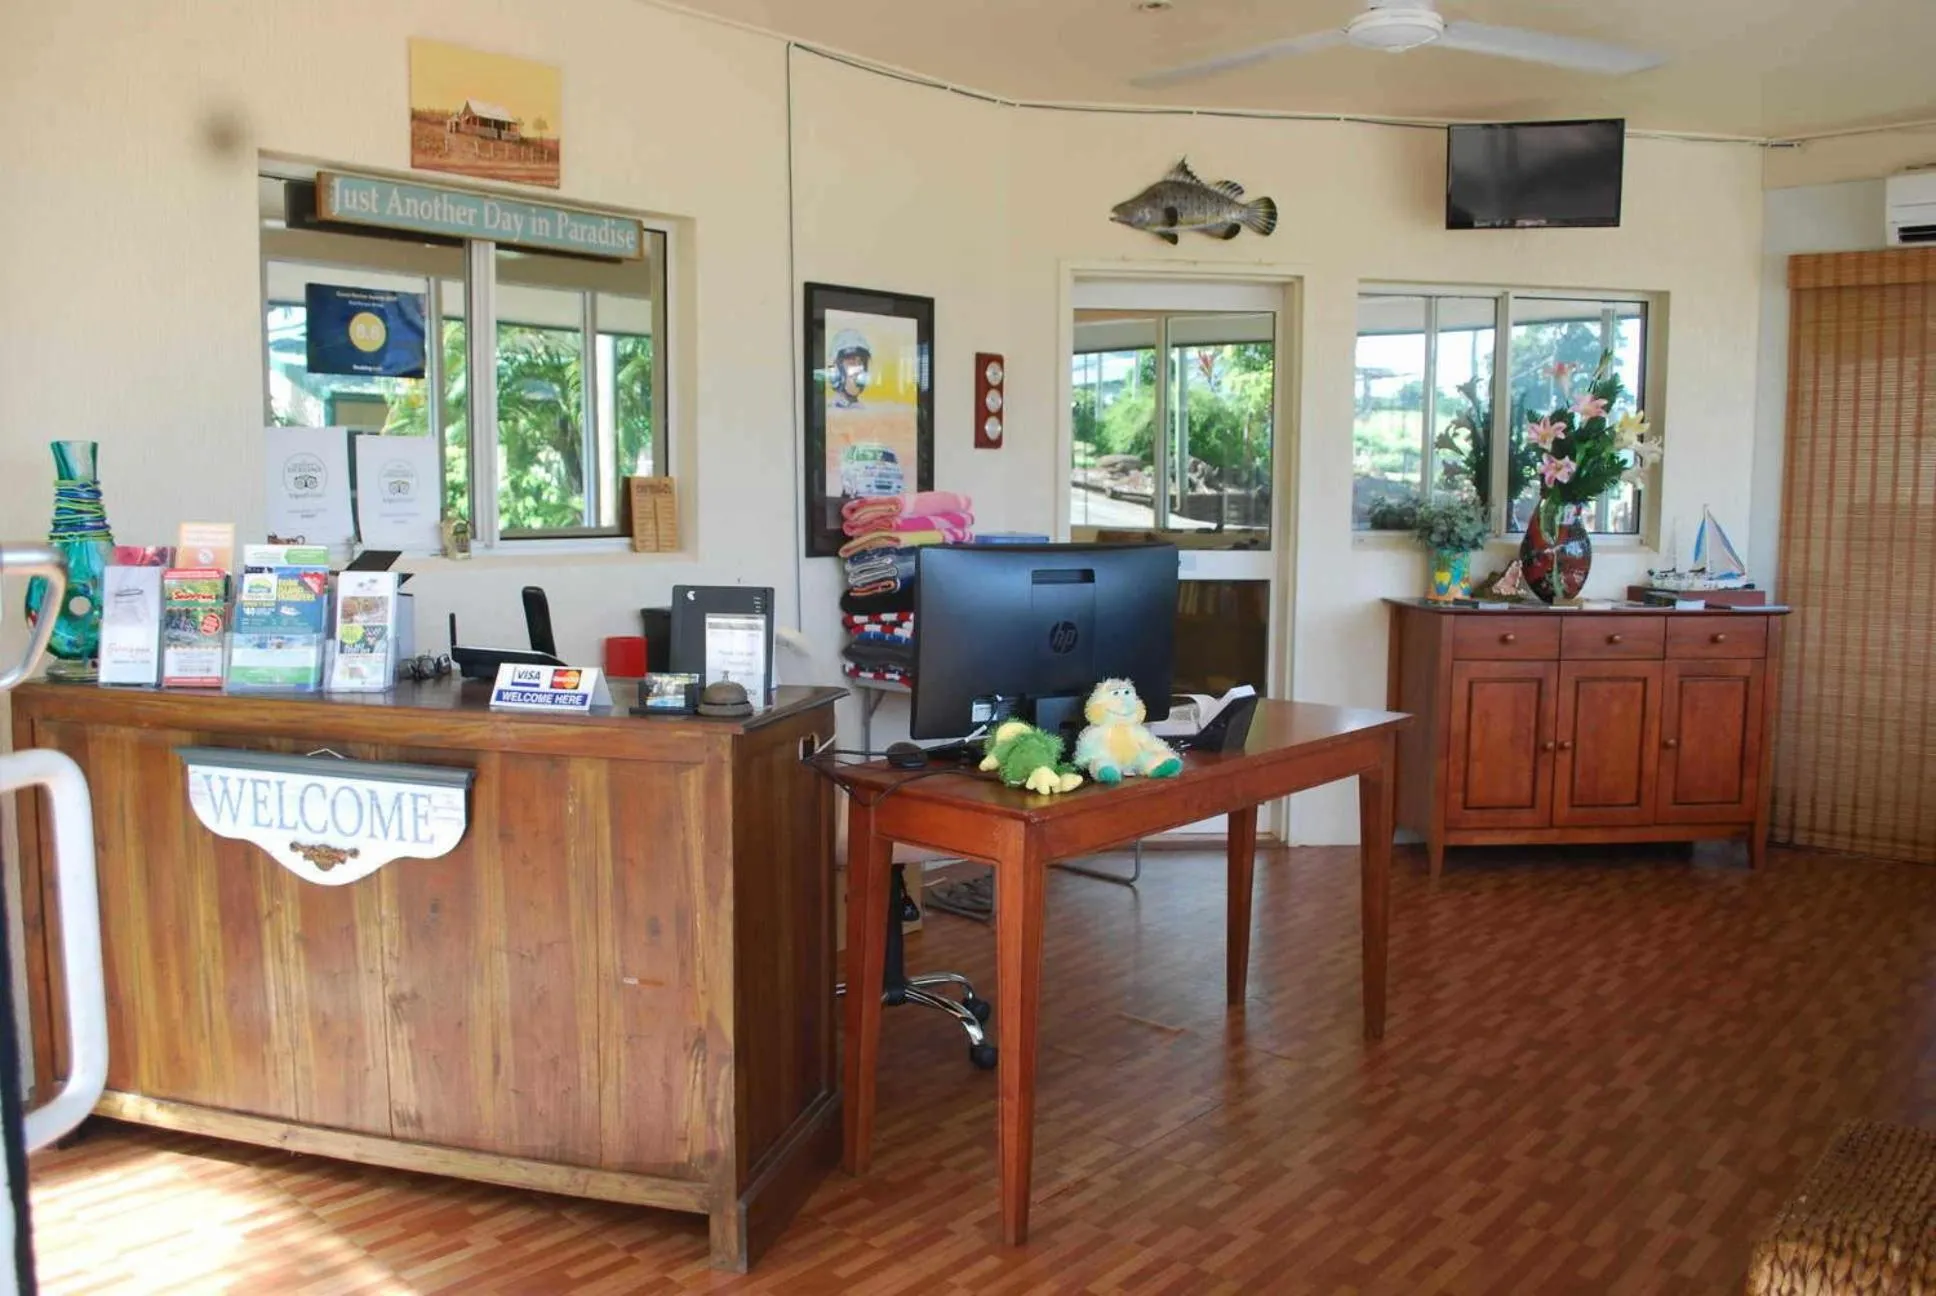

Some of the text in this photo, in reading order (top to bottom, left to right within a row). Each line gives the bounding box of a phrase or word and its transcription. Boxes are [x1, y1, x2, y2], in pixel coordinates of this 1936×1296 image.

[332, 177, 636, 249] Just Another Day in Paradise
[1052, 621, 1077, 655] hp
[517, 670, 541, 680] VISA
[502, 691, 583, 705] WELCOME HERE
[203, 773, 434, 844] WELCOME
